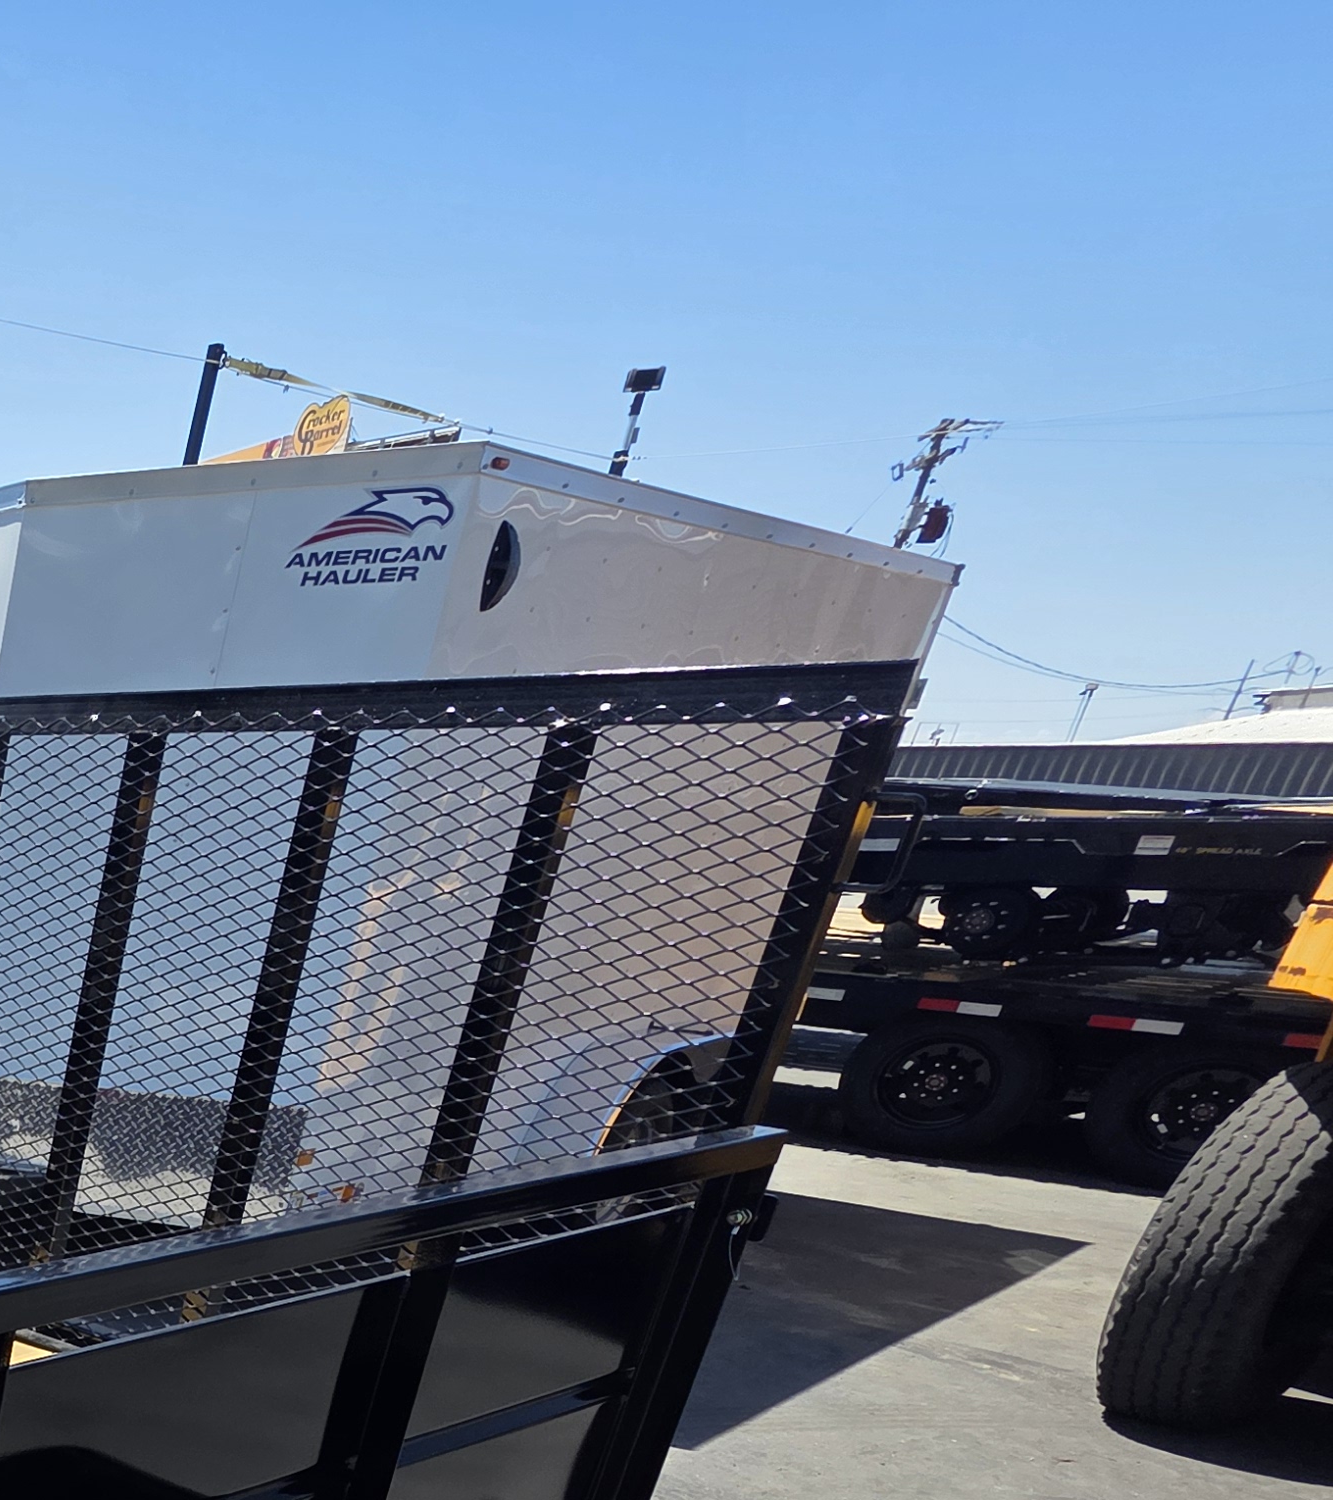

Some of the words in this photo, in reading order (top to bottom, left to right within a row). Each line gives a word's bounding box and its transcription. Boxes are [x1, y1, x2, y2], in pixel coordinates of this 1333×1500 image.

[301, 420, 343, 456] Barrel
[284, 545, 447, 569] AMERICAN
[300, 566, 420, 586] HAULER
